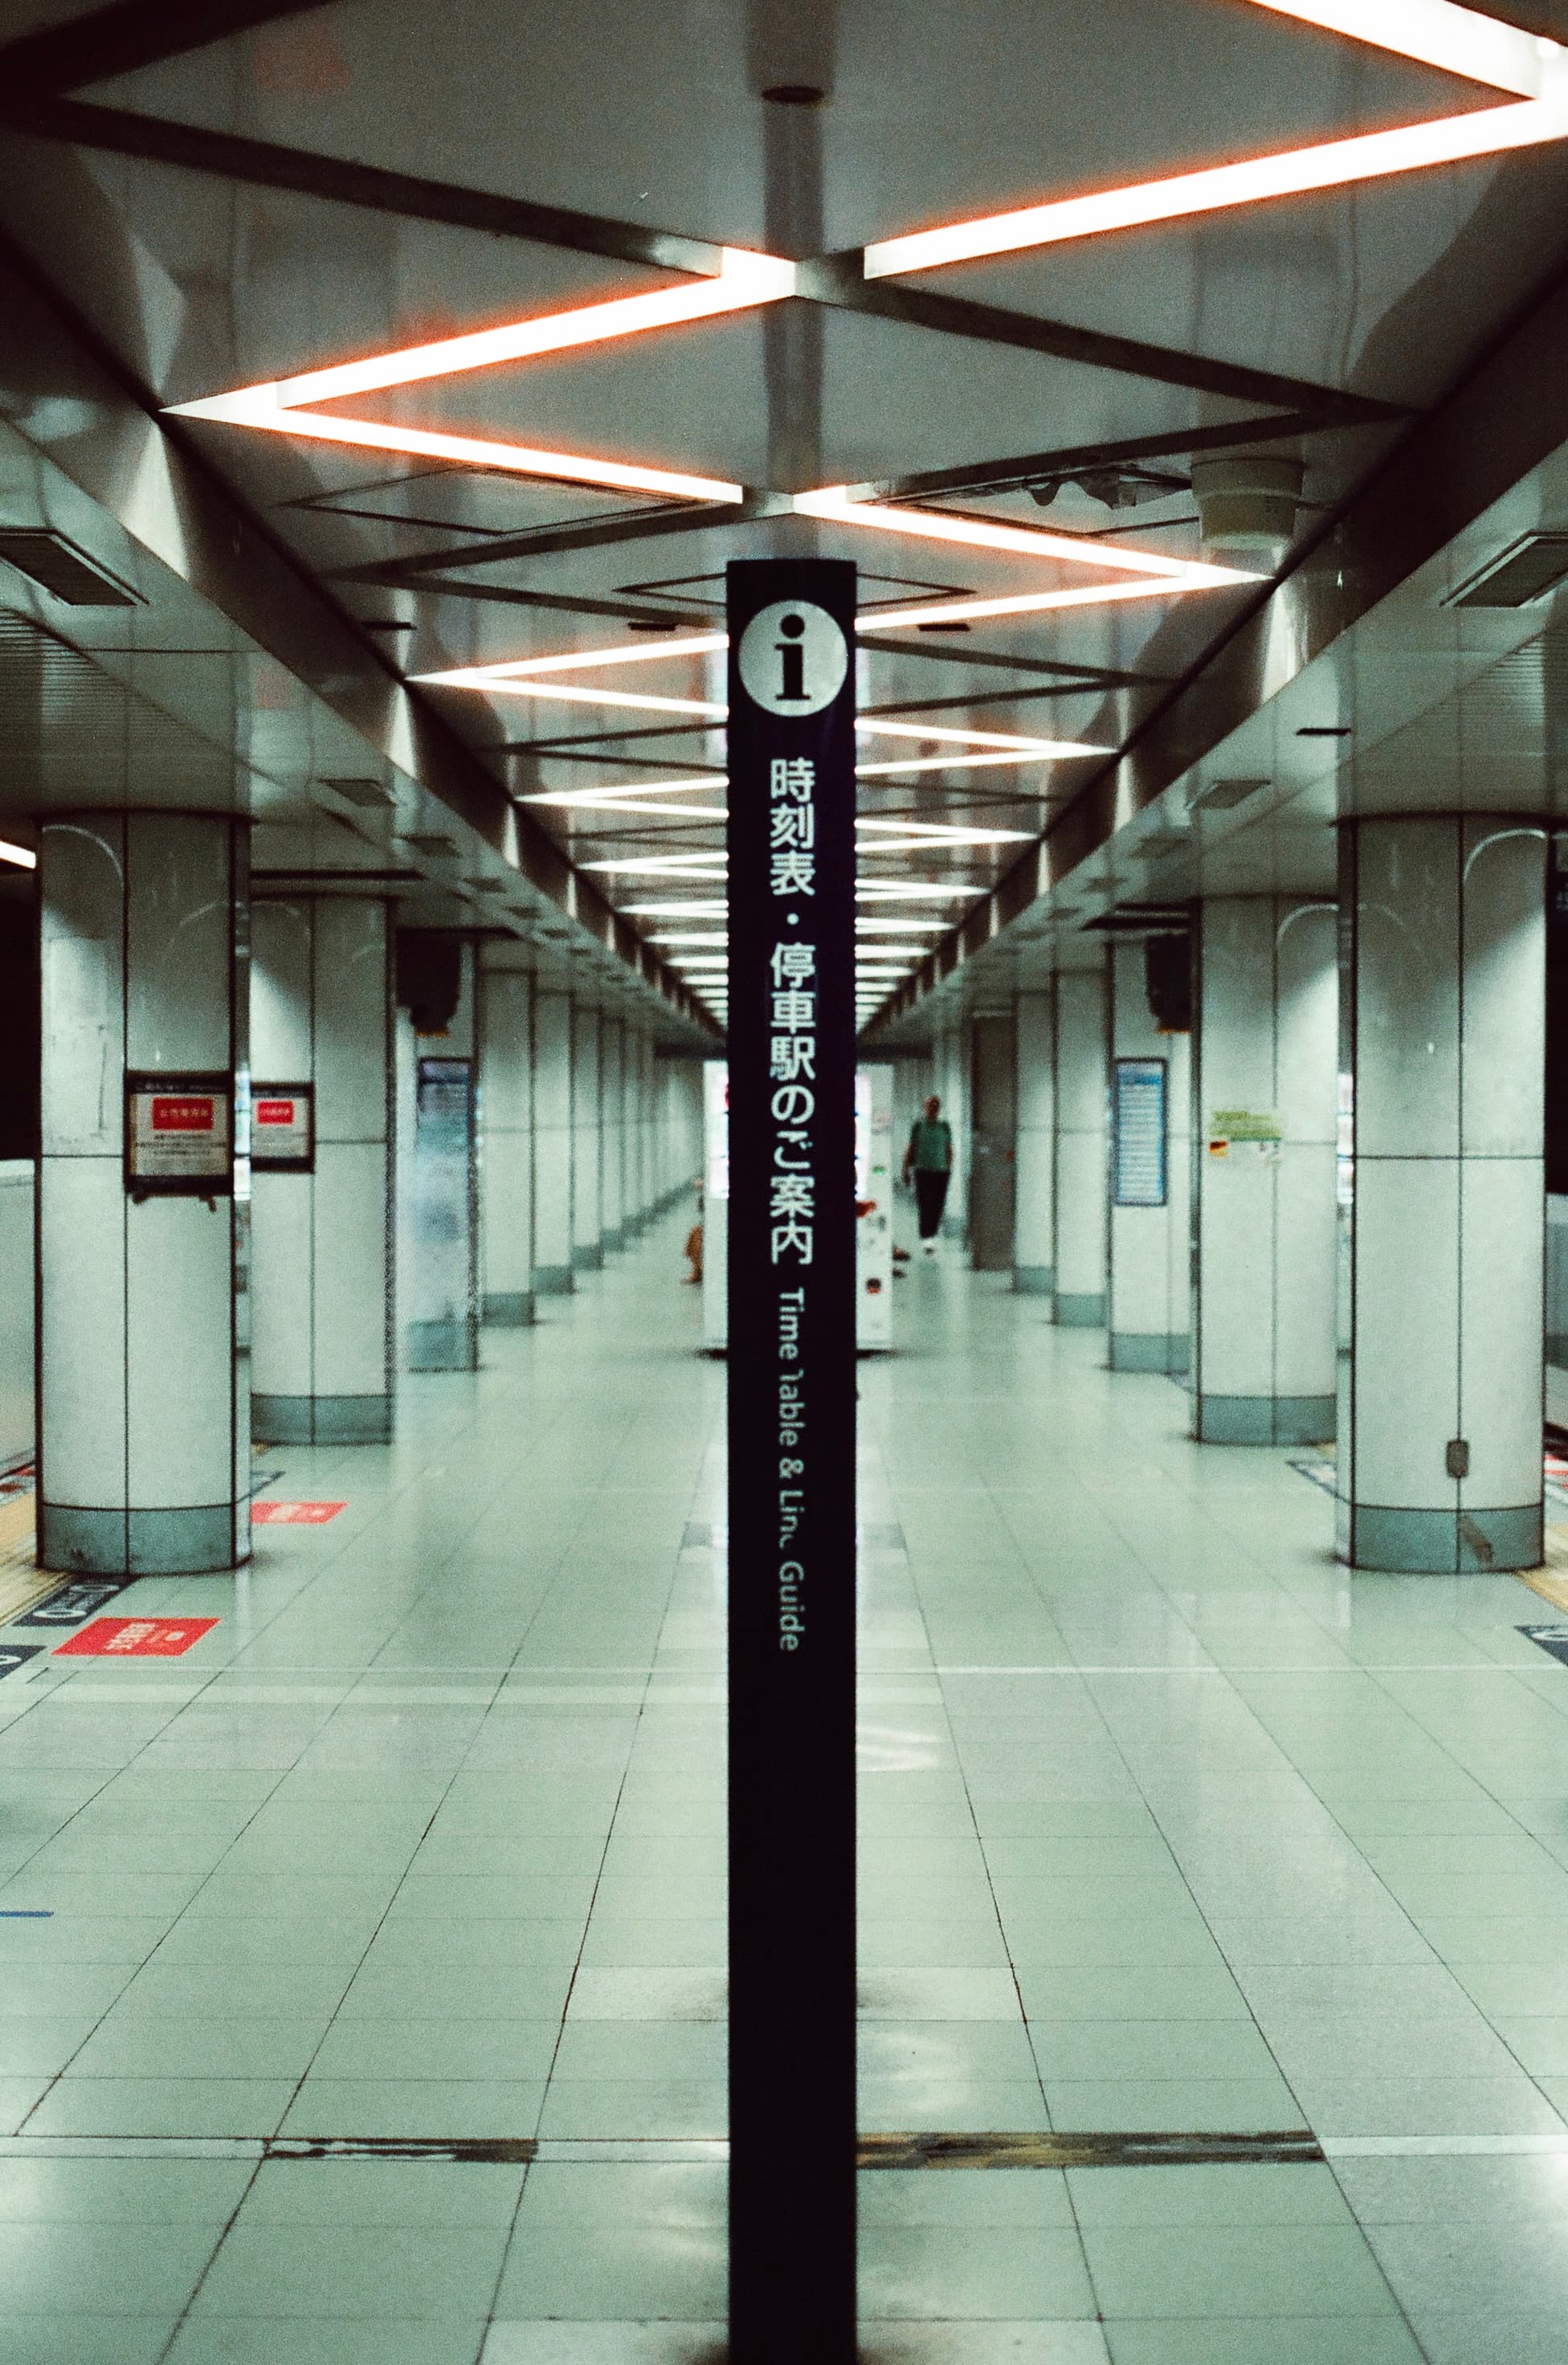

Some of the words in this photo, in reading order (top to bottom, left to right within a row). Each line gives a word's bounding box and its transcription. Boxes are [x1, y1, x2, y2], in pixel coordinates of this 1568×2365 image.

[770, 757, 816, 1264] 時刻表・停車駅のご案内
[779, 1287, 805, 1360] Time
[779, 1457, 804, 1479] &
[779, 1561, 805, 1651] Guide
